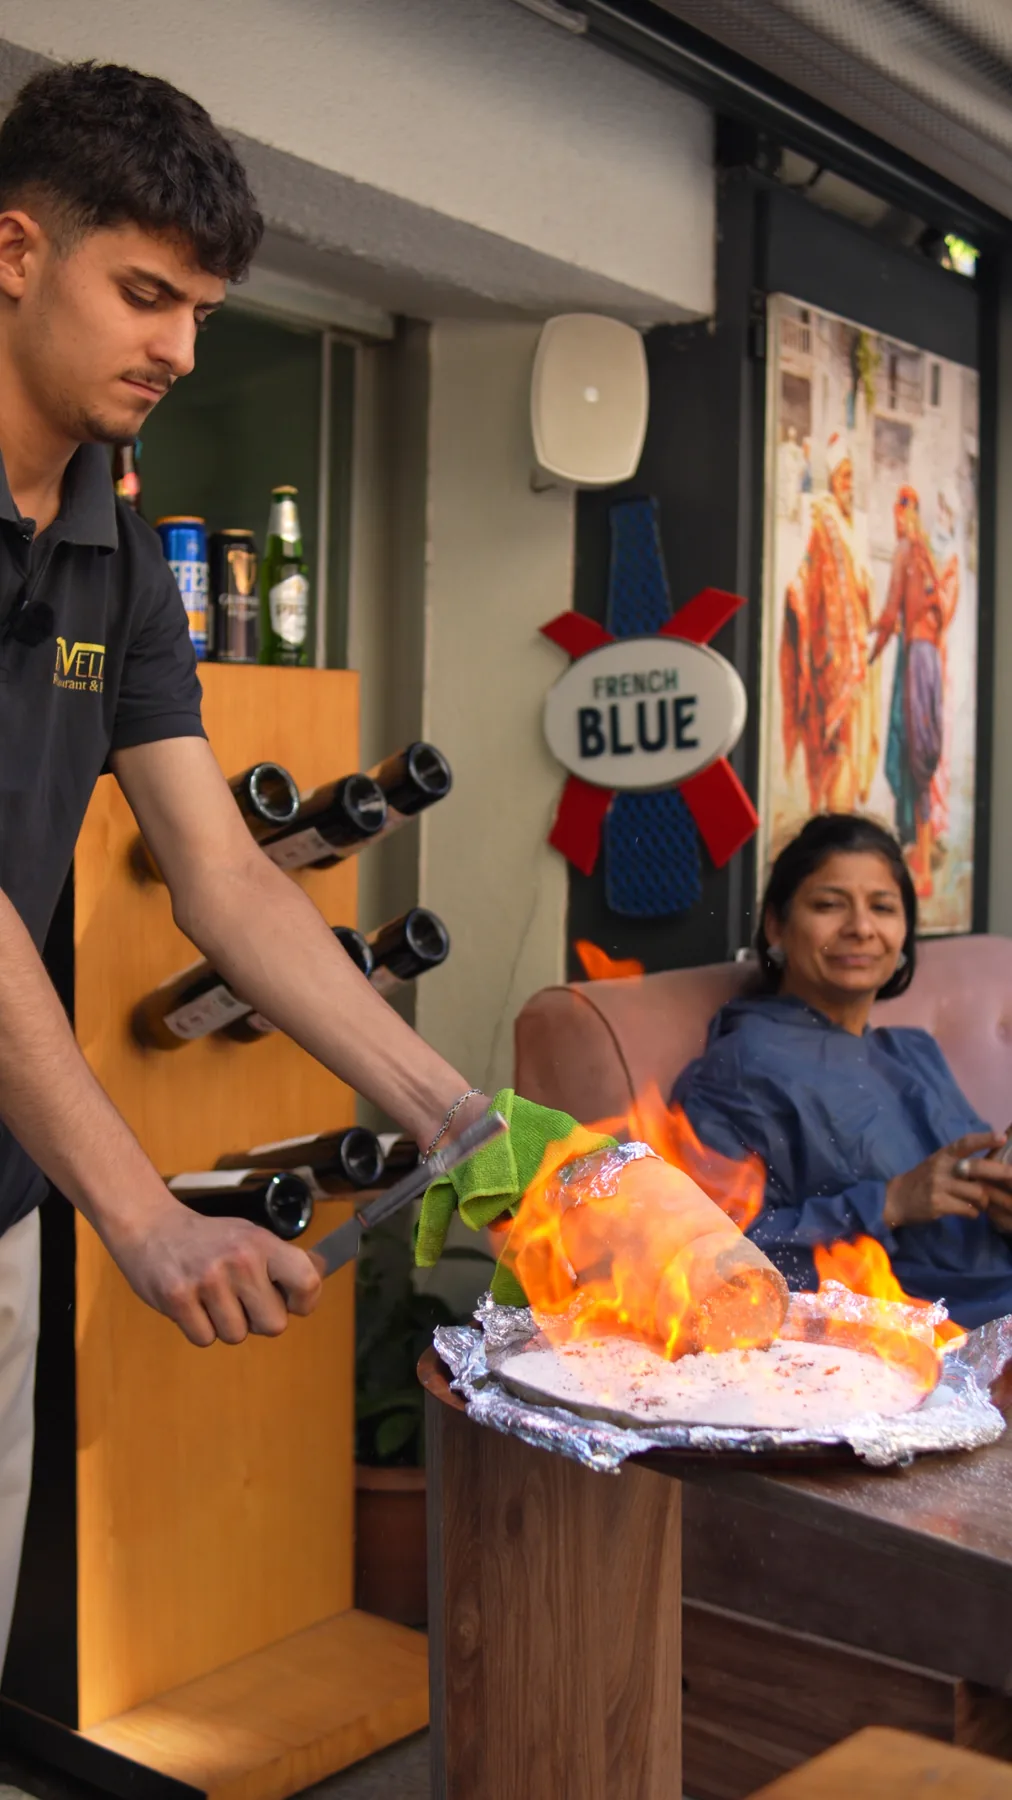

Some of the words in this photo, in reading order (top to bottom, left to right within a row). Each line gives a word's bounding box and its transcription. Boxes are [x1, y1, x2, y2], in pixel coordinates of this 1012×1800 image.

[89, 679, 98, 692] &
[593, 668, 679, 698] FRENCH
[578, 694, 699, 759] BLUE
